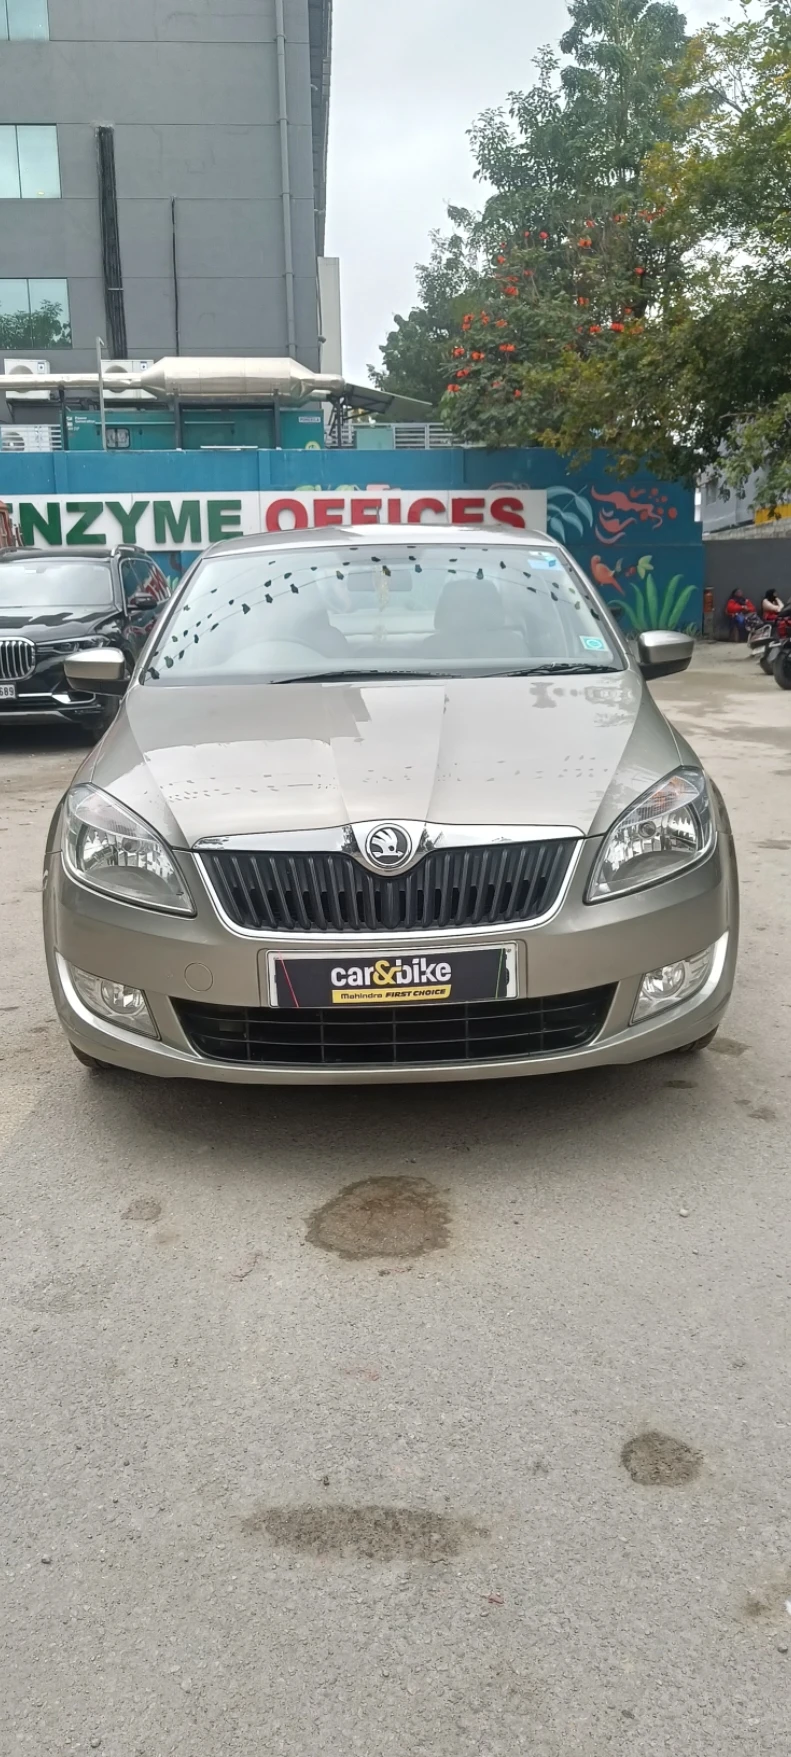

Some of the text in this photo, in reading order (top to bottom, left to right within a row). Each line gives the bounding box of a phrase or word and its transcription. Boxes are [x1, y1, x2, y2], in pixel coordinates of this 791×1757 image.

[0, 500, 244, 546] NZYME
[330, 957, 452, 987] car&bike
[340, 988, 446, 1000] Mahindra FIRST CHOICE
